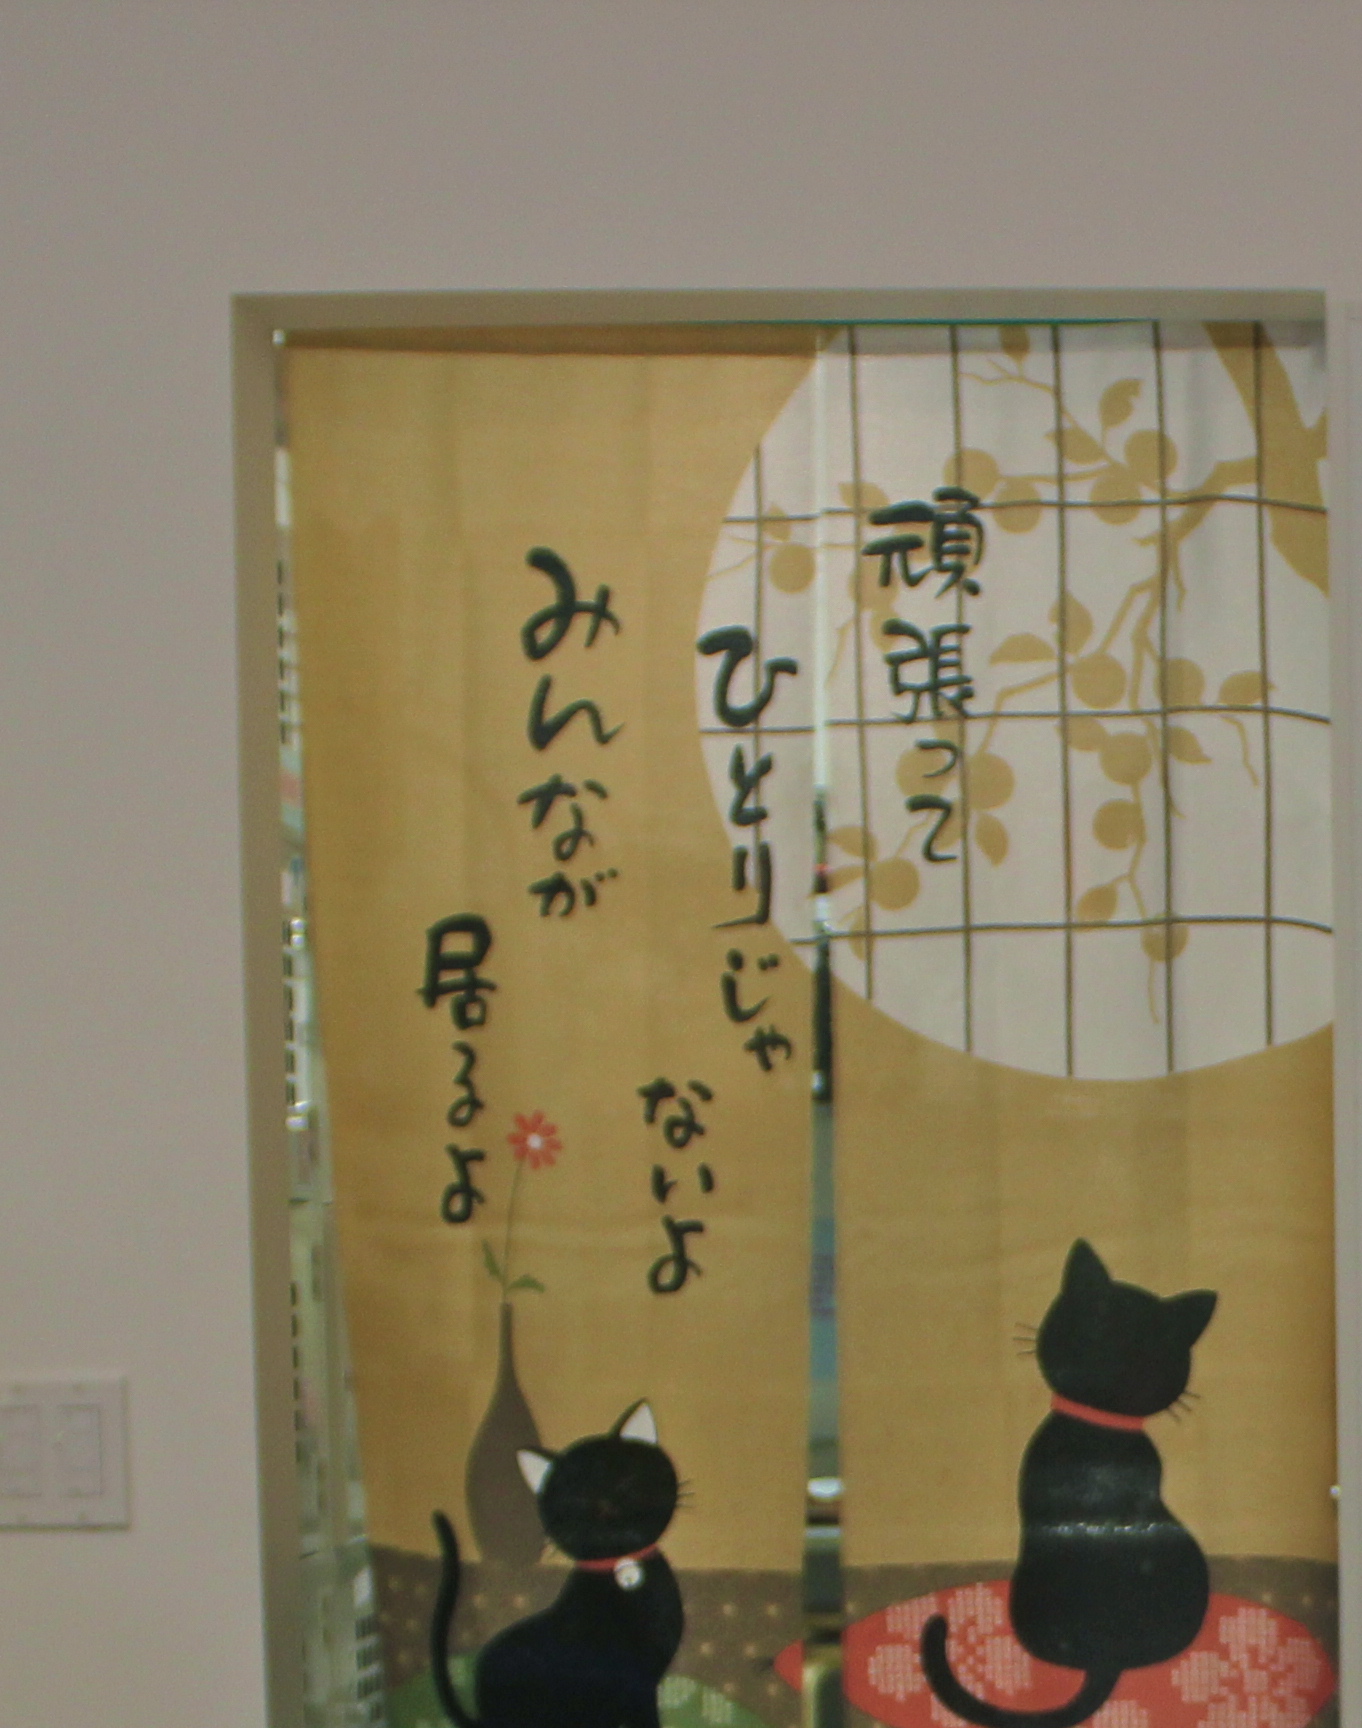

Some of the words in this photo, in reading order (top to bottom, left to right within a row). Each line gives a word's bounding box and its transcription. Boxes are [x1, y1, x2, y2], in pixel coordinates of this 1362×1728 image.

[519, 546, 624, 918] みんなが
[696, 626, 798, 1073] ひとりじゃ
[862, 487, 986, 863] 頑張って
[417, 913, 497, 1224] 居るよ
[638, 1078, 715, 1295] ないよ
